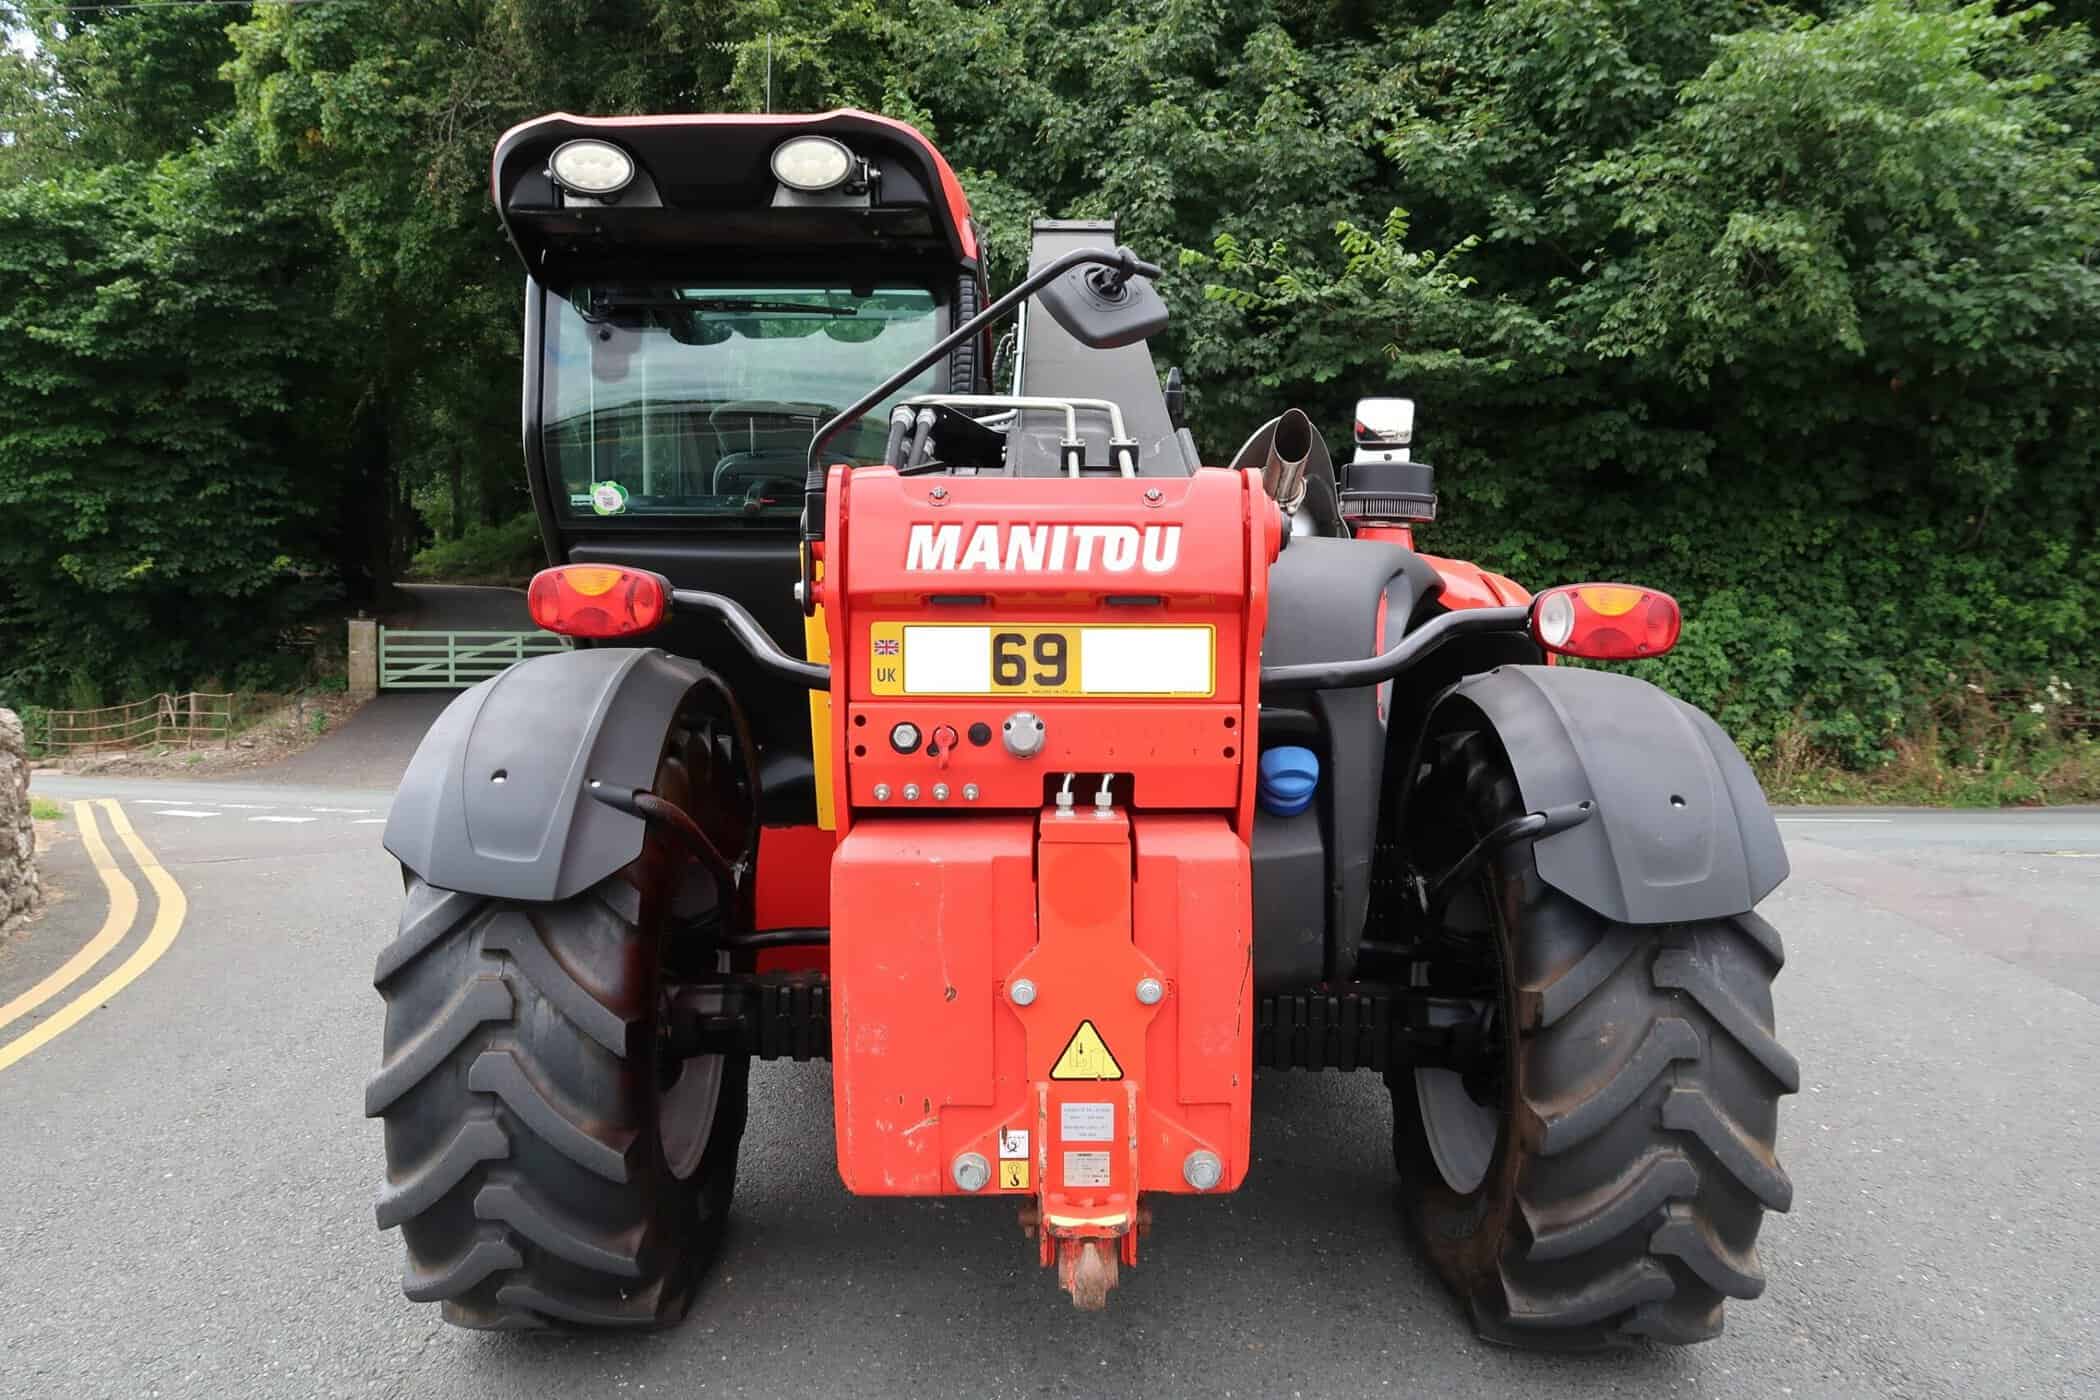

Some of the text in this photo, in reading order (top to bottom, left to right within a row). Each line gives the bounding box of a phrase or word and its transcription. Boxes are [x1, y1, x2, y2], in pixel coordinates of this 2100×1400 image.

[905, 524, 1183, 573] MANITOU
[876, 667, 897, 683] UK
[992, 632, 1068, 687] 69
